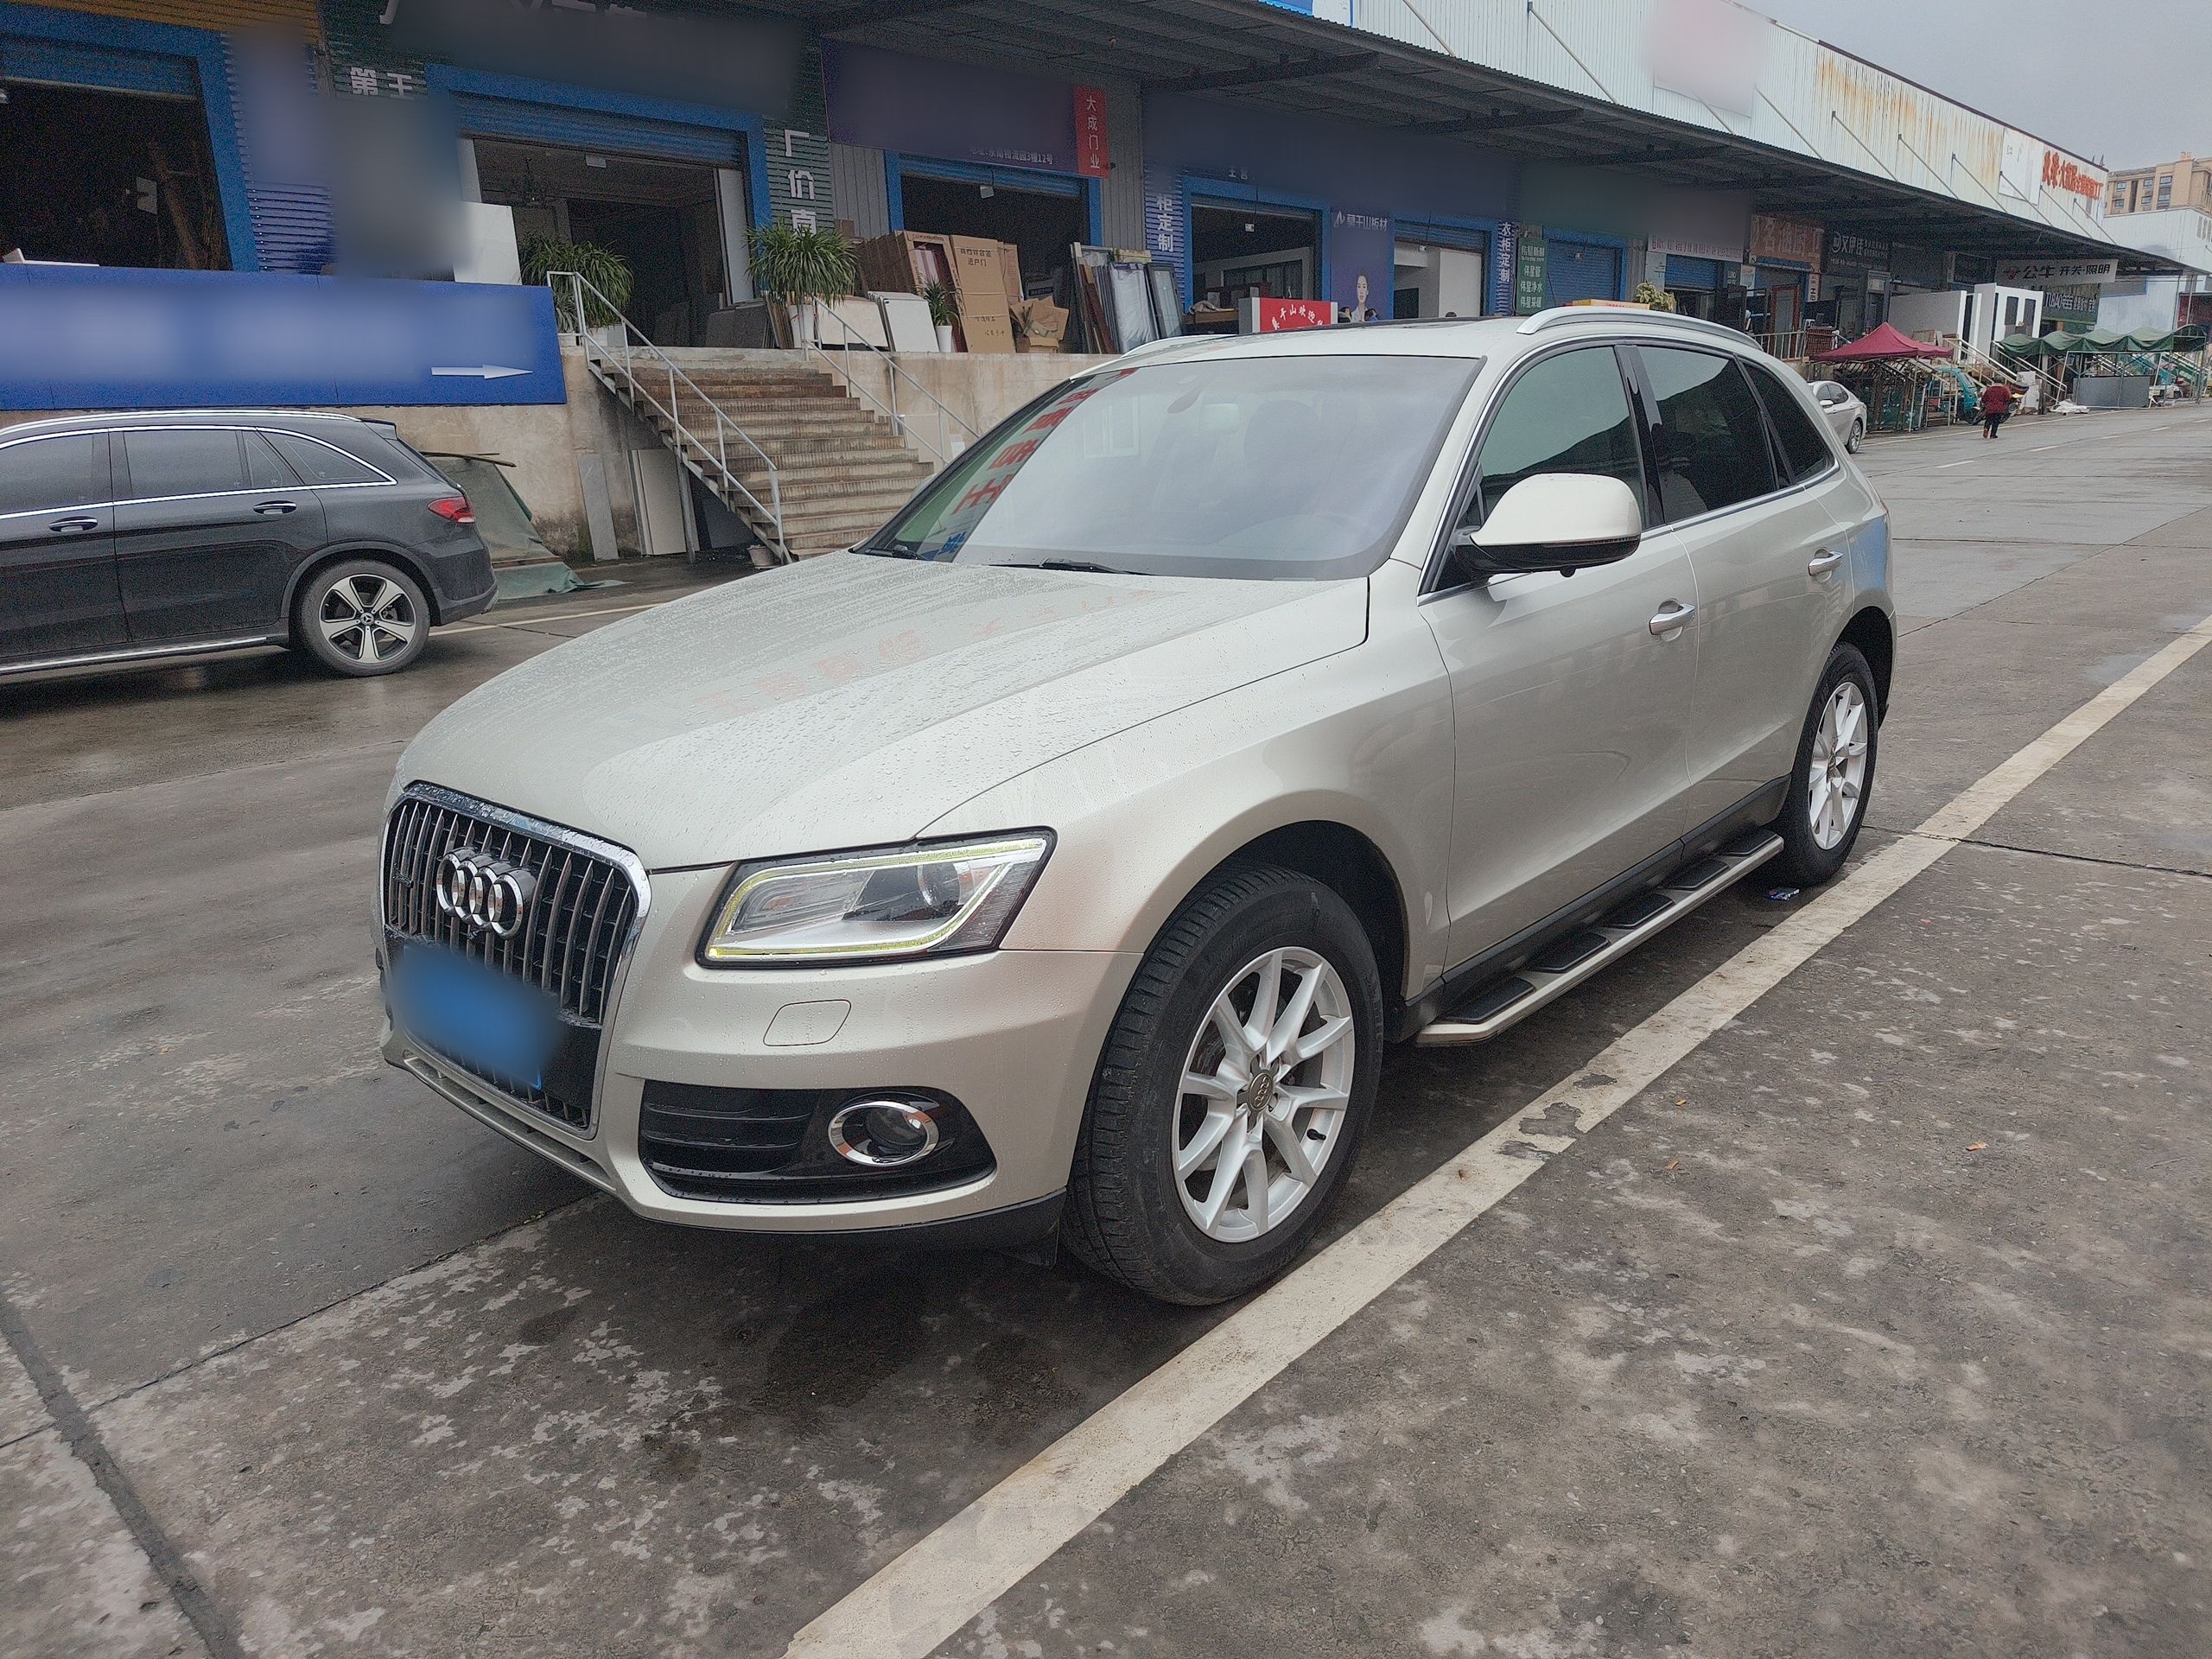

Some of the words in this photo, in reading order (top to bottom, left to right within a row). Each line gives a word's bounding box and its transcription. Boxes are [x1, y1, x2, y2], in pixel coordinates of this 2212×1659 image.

[1086, 94, 1101, 169] 大成门业
[1347, 213, 1389, 232] 莫干山板材
[1500, 221, 1512, 283] 衣柜定制
[2022, 264, 2056, 278] 公牛
[2060, 264, 2111, 276] 开关·照明
